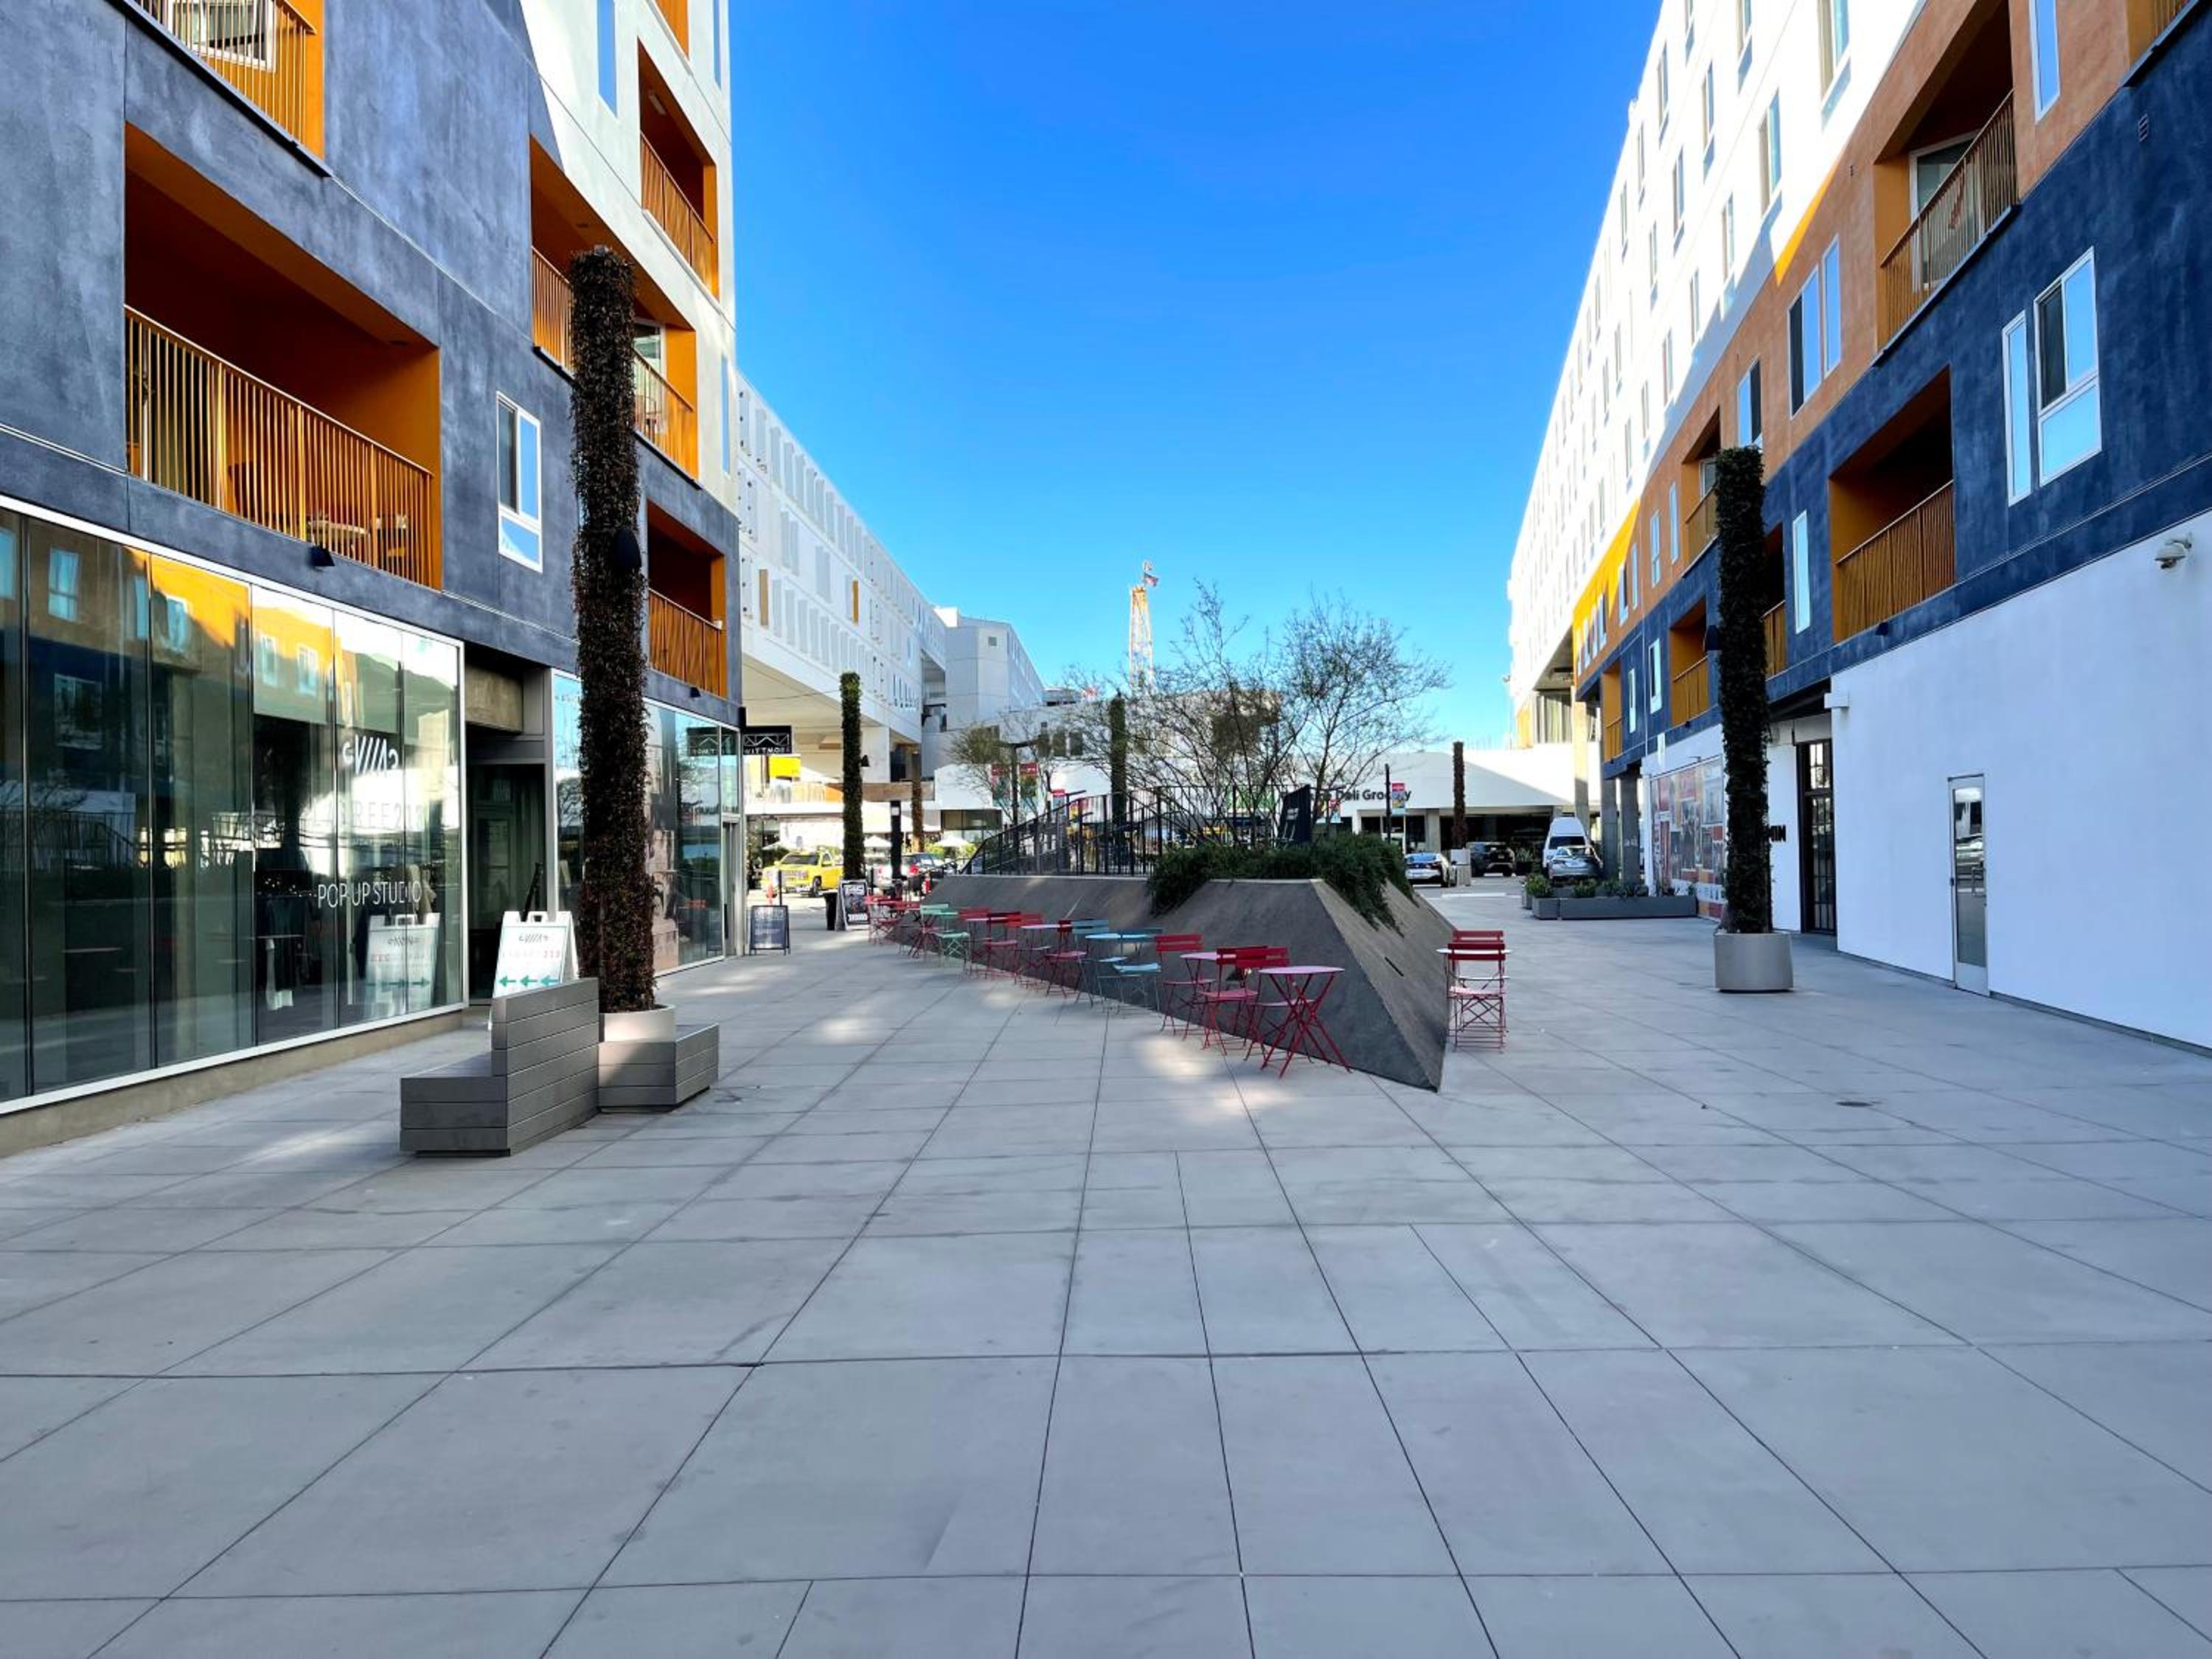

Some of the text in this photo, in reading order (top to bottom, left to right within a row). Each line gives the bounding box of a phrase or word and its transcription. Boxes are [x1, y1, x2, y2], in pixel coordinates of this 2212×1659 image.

[1363, 789, 1411, 801] Groy
[318, 880, 422, 908] POP UP STUDIO
